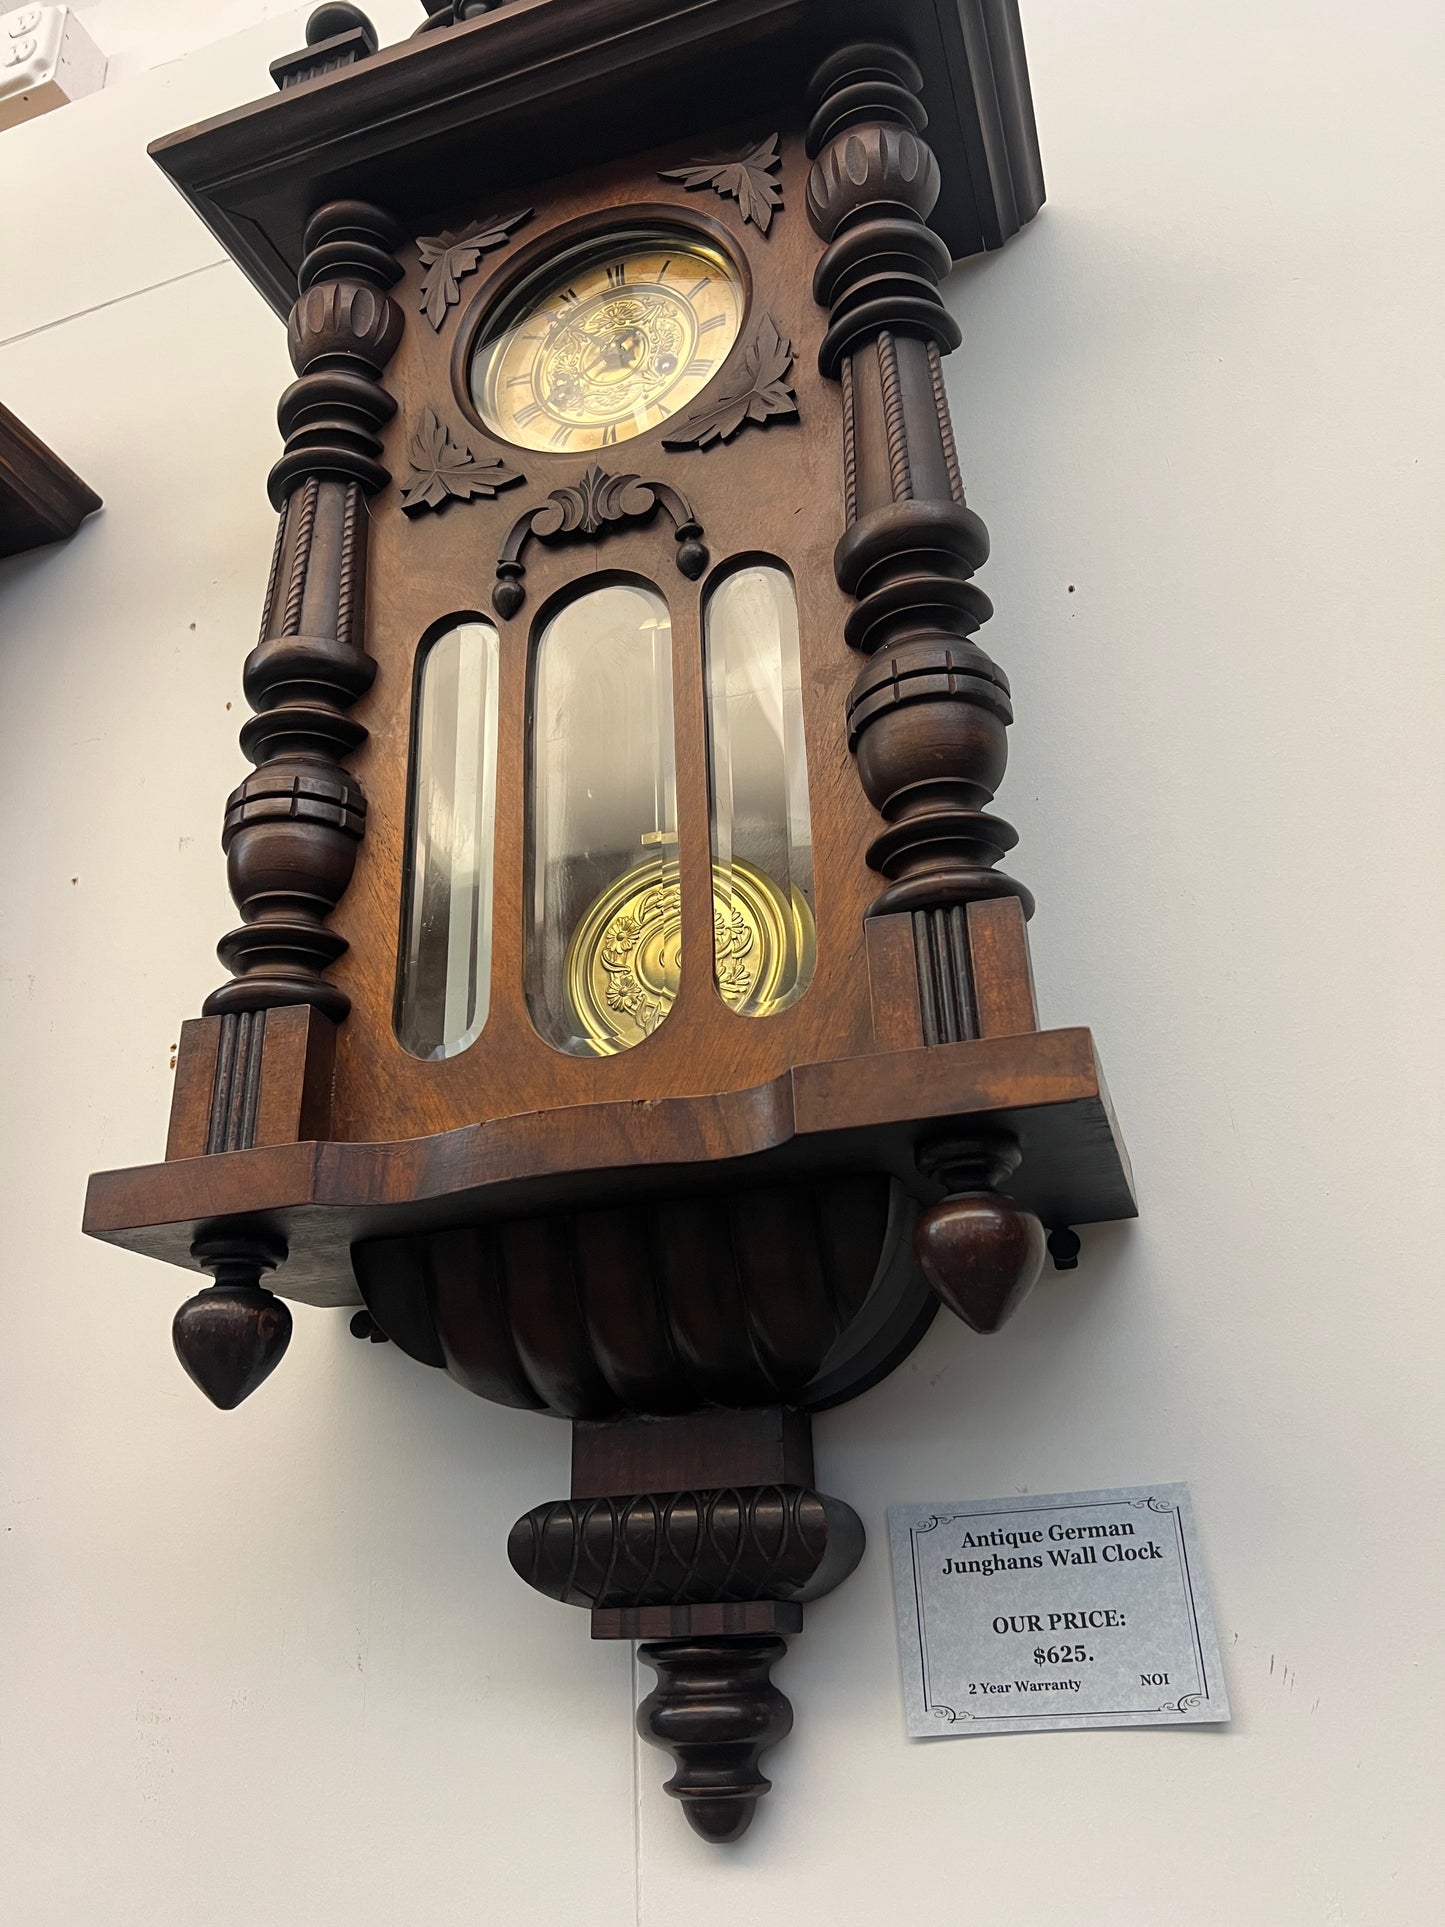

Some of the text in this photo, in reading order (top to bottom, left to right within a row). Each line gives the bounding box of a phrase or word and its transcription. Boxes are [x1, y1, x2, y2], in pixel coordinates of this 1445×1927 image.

[960, 1522, 1136, 1549] Antique German
[942, 1541, 1164, 1576] Junghans Wall Clock
[992, 1610, 1127, 1634] OUR PRICE:
[1033, 1644, 1095, 1667] $625.
[968, 1679, 1082, 1695] 2 Year Warranty
[1140, 1673, 1171, 1686] NOI
